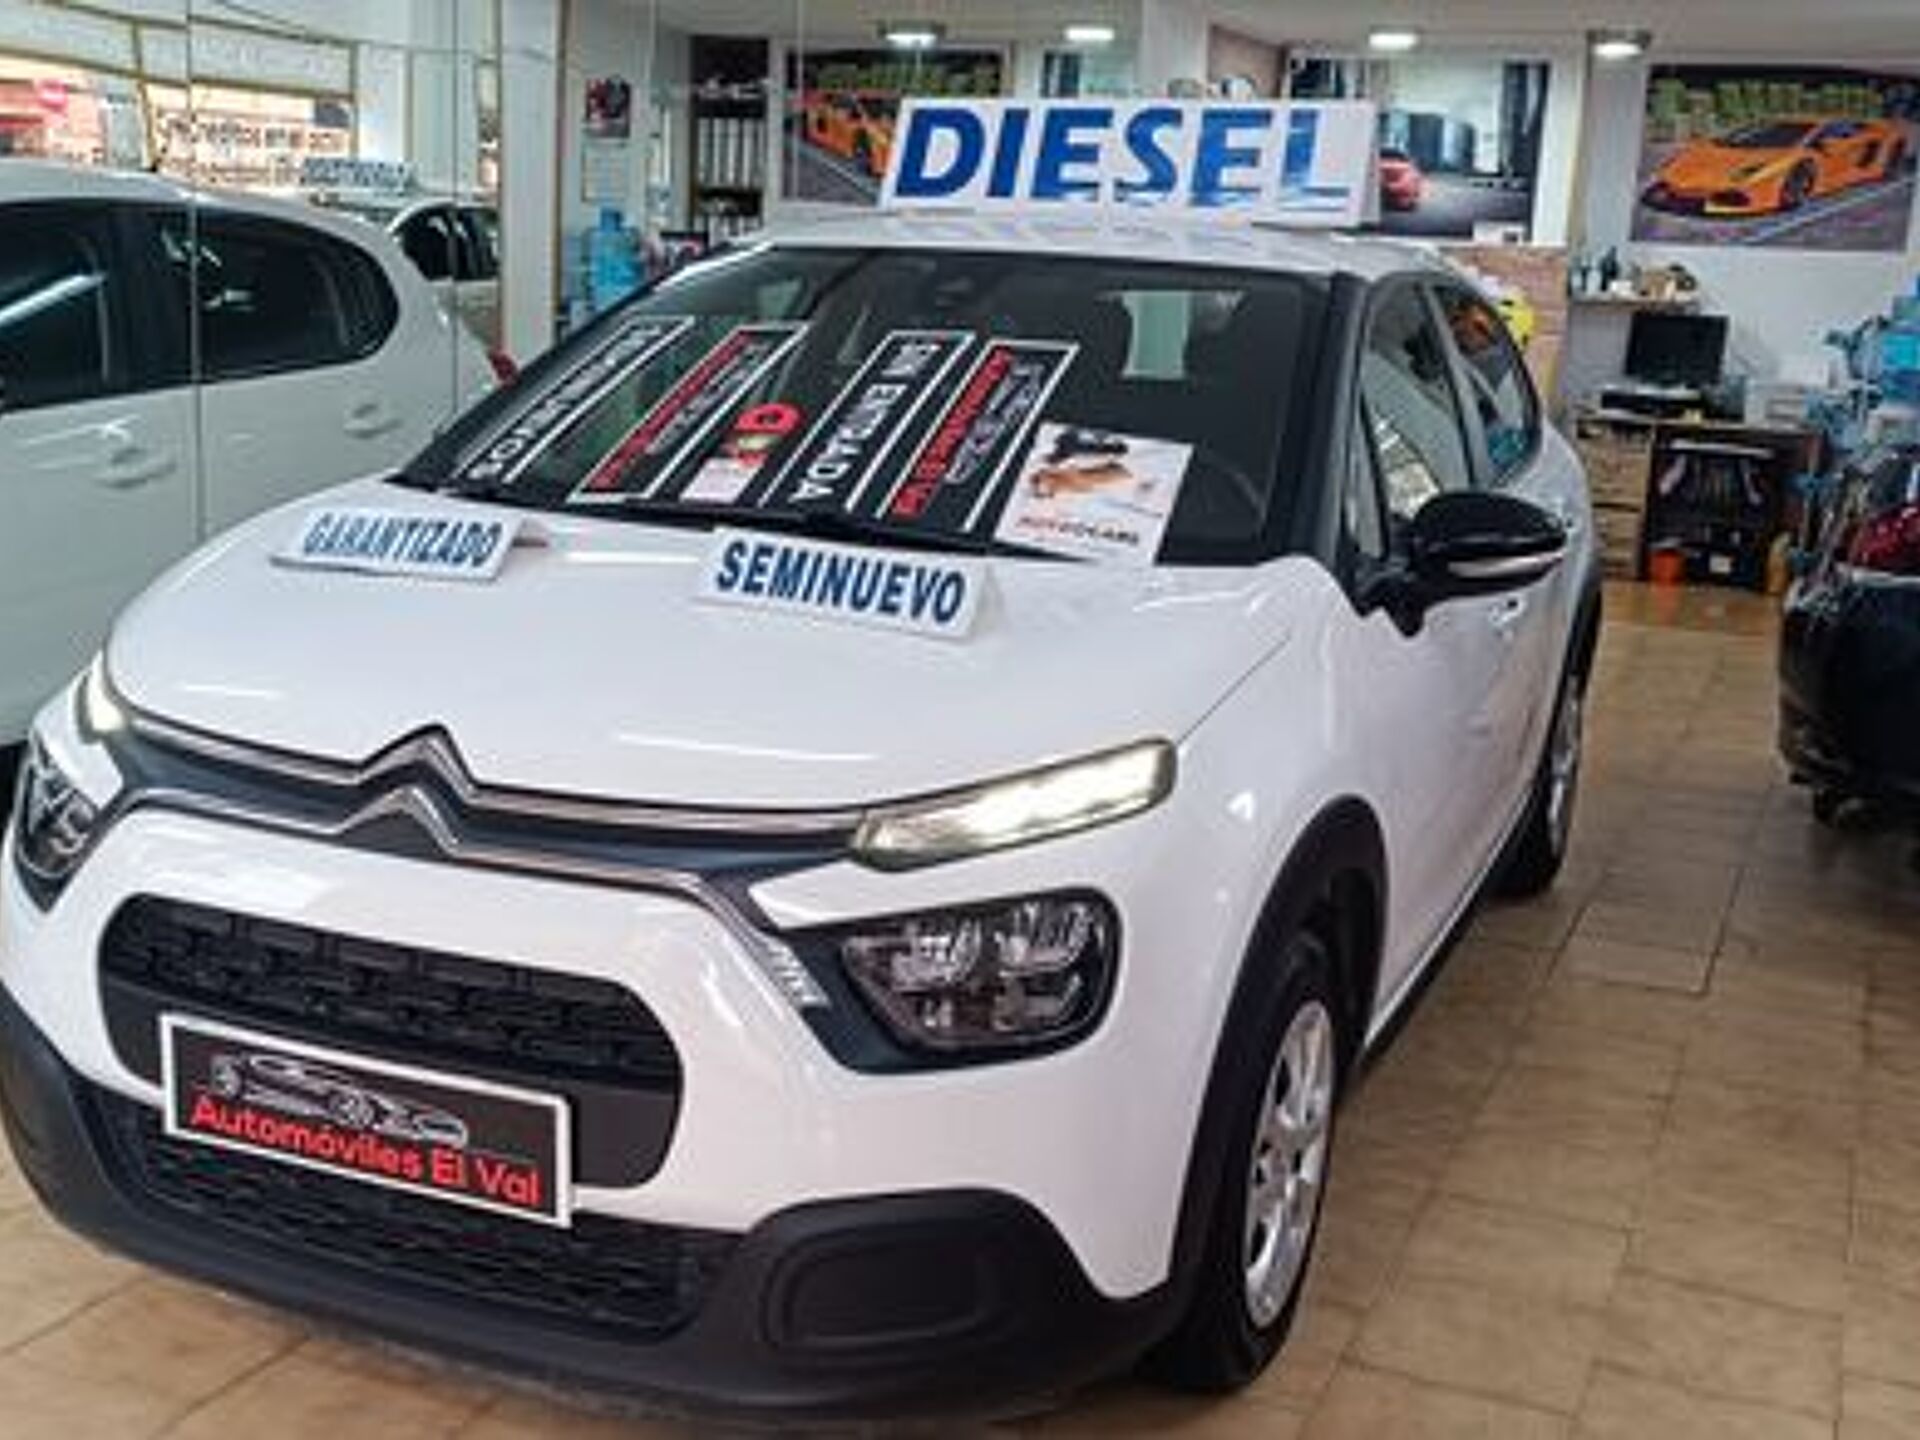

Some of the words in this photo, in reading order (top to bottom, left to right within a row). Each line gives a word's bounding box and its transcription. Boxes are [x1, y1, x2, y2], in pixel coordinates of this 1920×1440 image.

[895, 107, 1350, 210] DIESEL
[304, 512, 502, 568] GARANTIZADO
[716, 540, 966, 622] SEMINUEVO
[431, 1147, 466, 1186] El
[475, 1156, 540, 1205] Val
